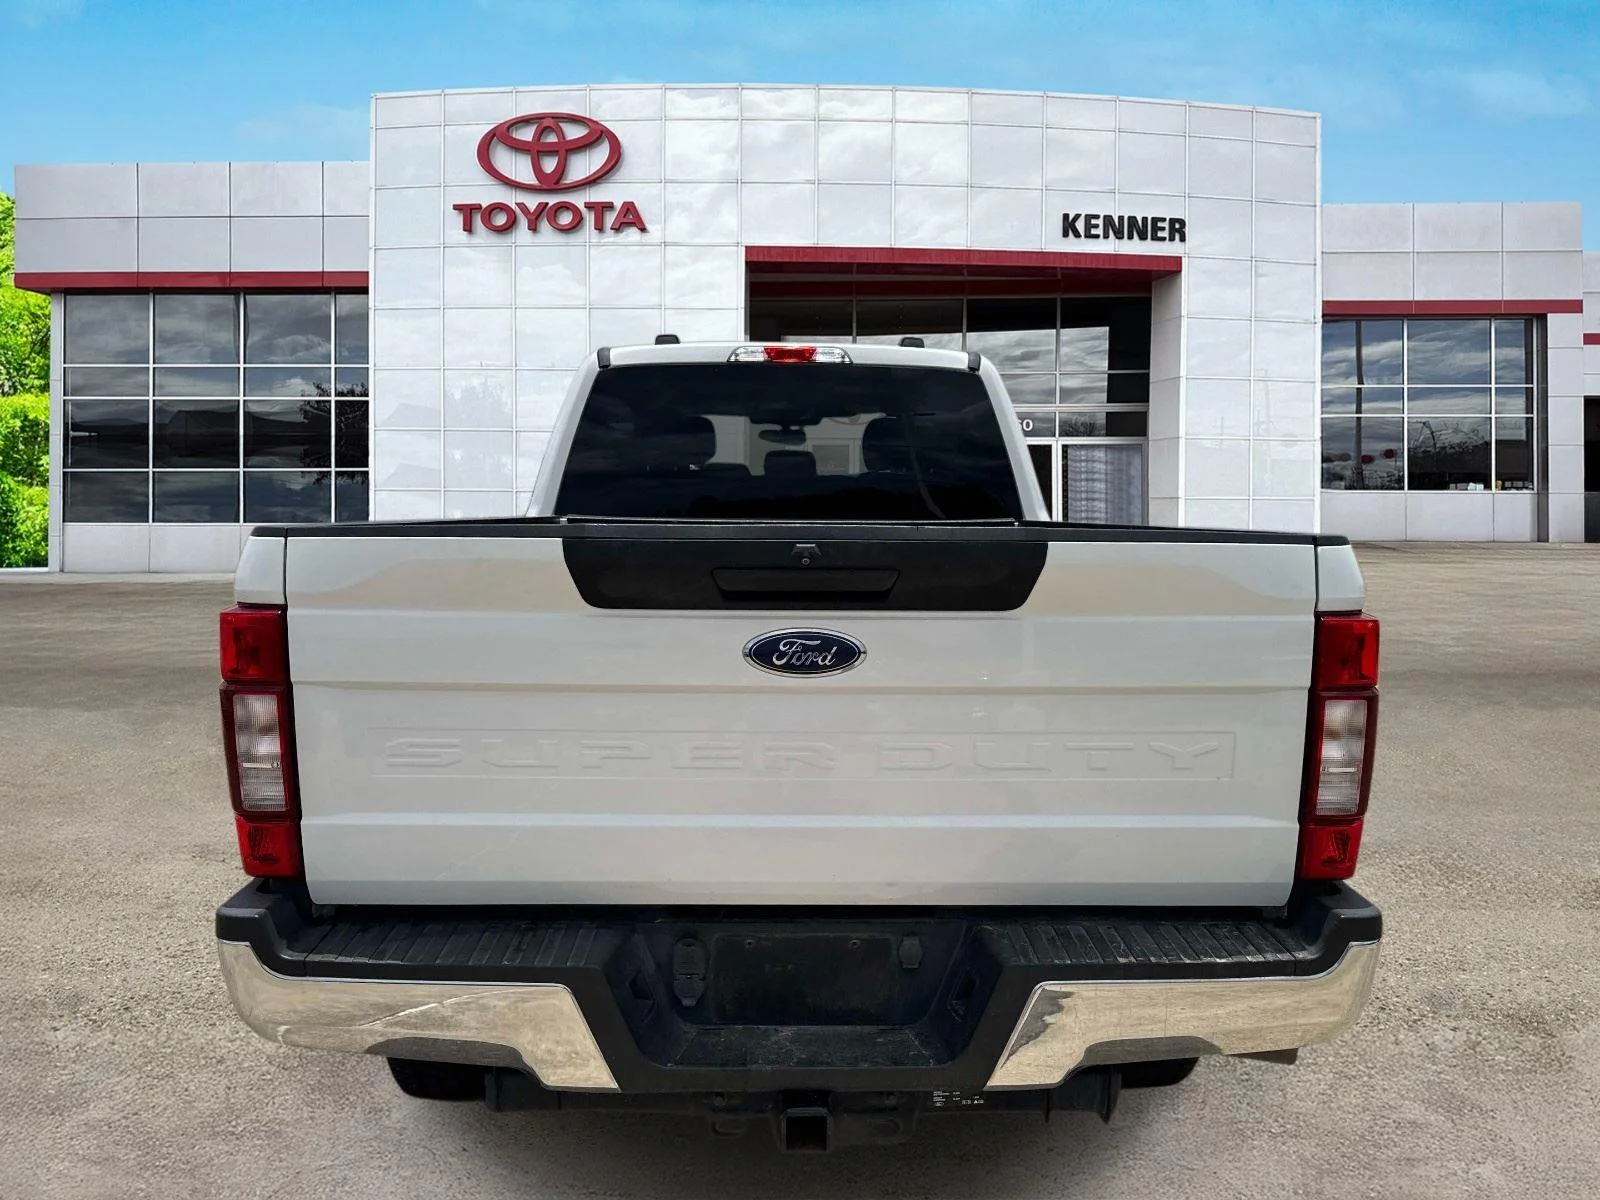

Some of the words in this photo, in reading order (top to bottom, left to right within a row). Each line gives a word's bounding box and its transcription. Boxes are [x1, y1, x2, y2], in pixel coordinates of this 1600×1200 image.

[452, 201, 648, 233] TOYOTA
[1061, 213, 1187, 243] KENNER
[772, 638, 838, 666] Ford
[384, 738, 837, 770] SUPER
[876, 741, 1219, 771] DUTY
